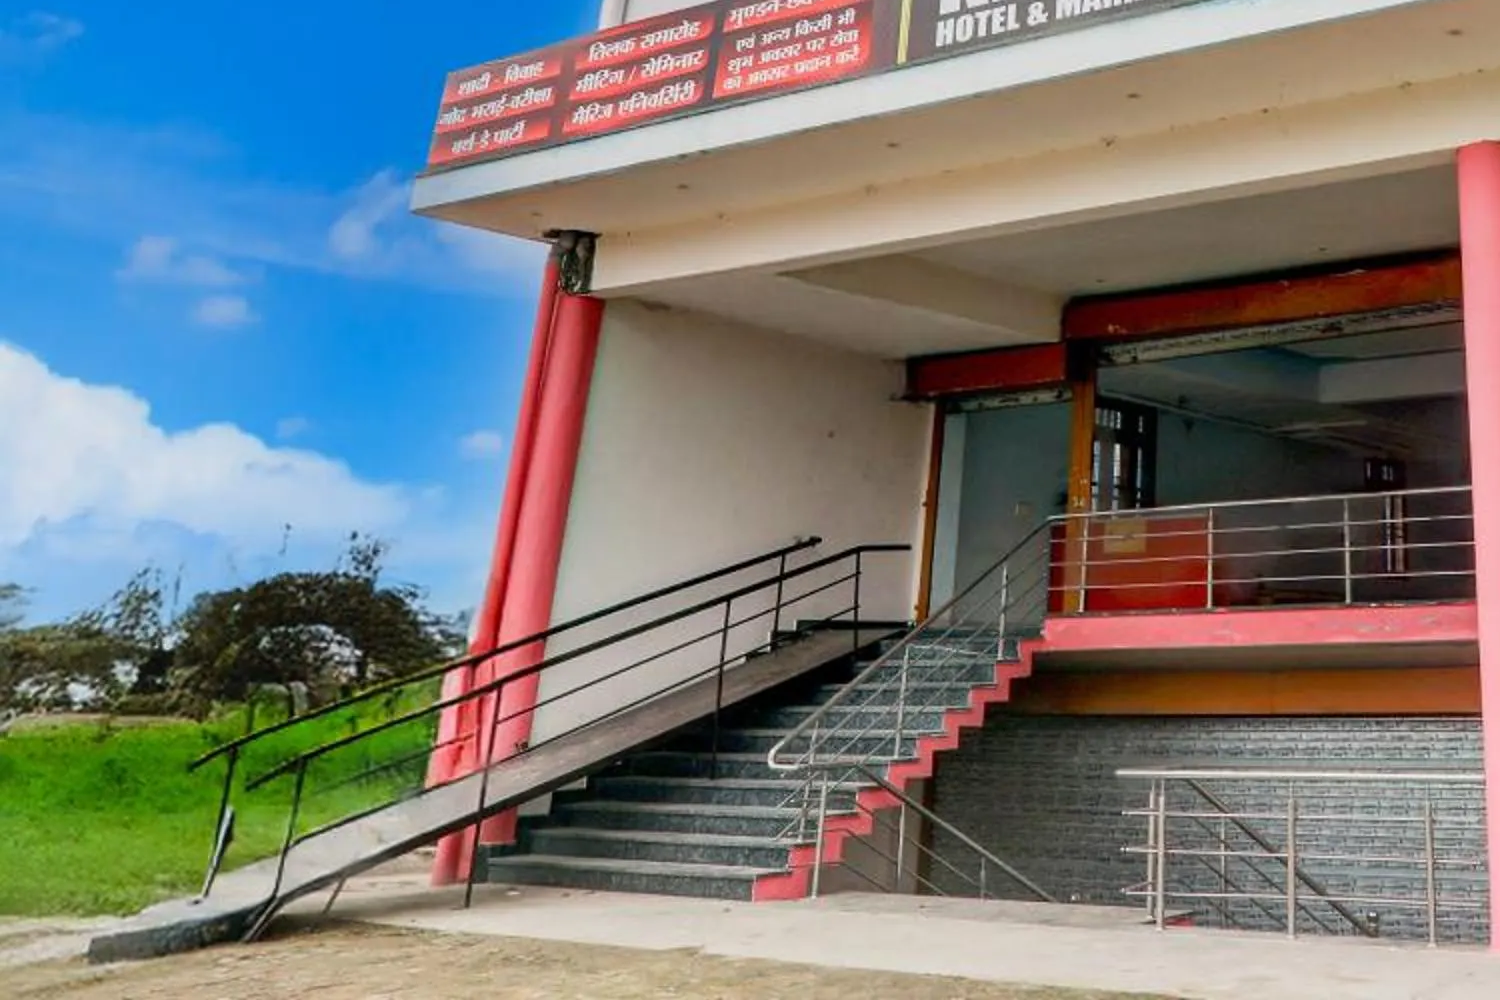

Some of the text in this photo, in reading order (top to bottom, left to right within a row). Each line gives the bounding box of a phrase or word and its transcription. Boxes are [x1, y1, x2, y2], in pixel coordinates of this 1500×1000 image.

[795, 13, 833, 37] किसी
[838, 7, 856, 25] भी
[936, 5, 1019, 48] HOTEL
[1027, 1, 1048, 27] &
[588, 19, 702, 63] तिलक समारोह
[806, 38, 827, 52] पर
[640, 49, 705, 78] सेमिनार
